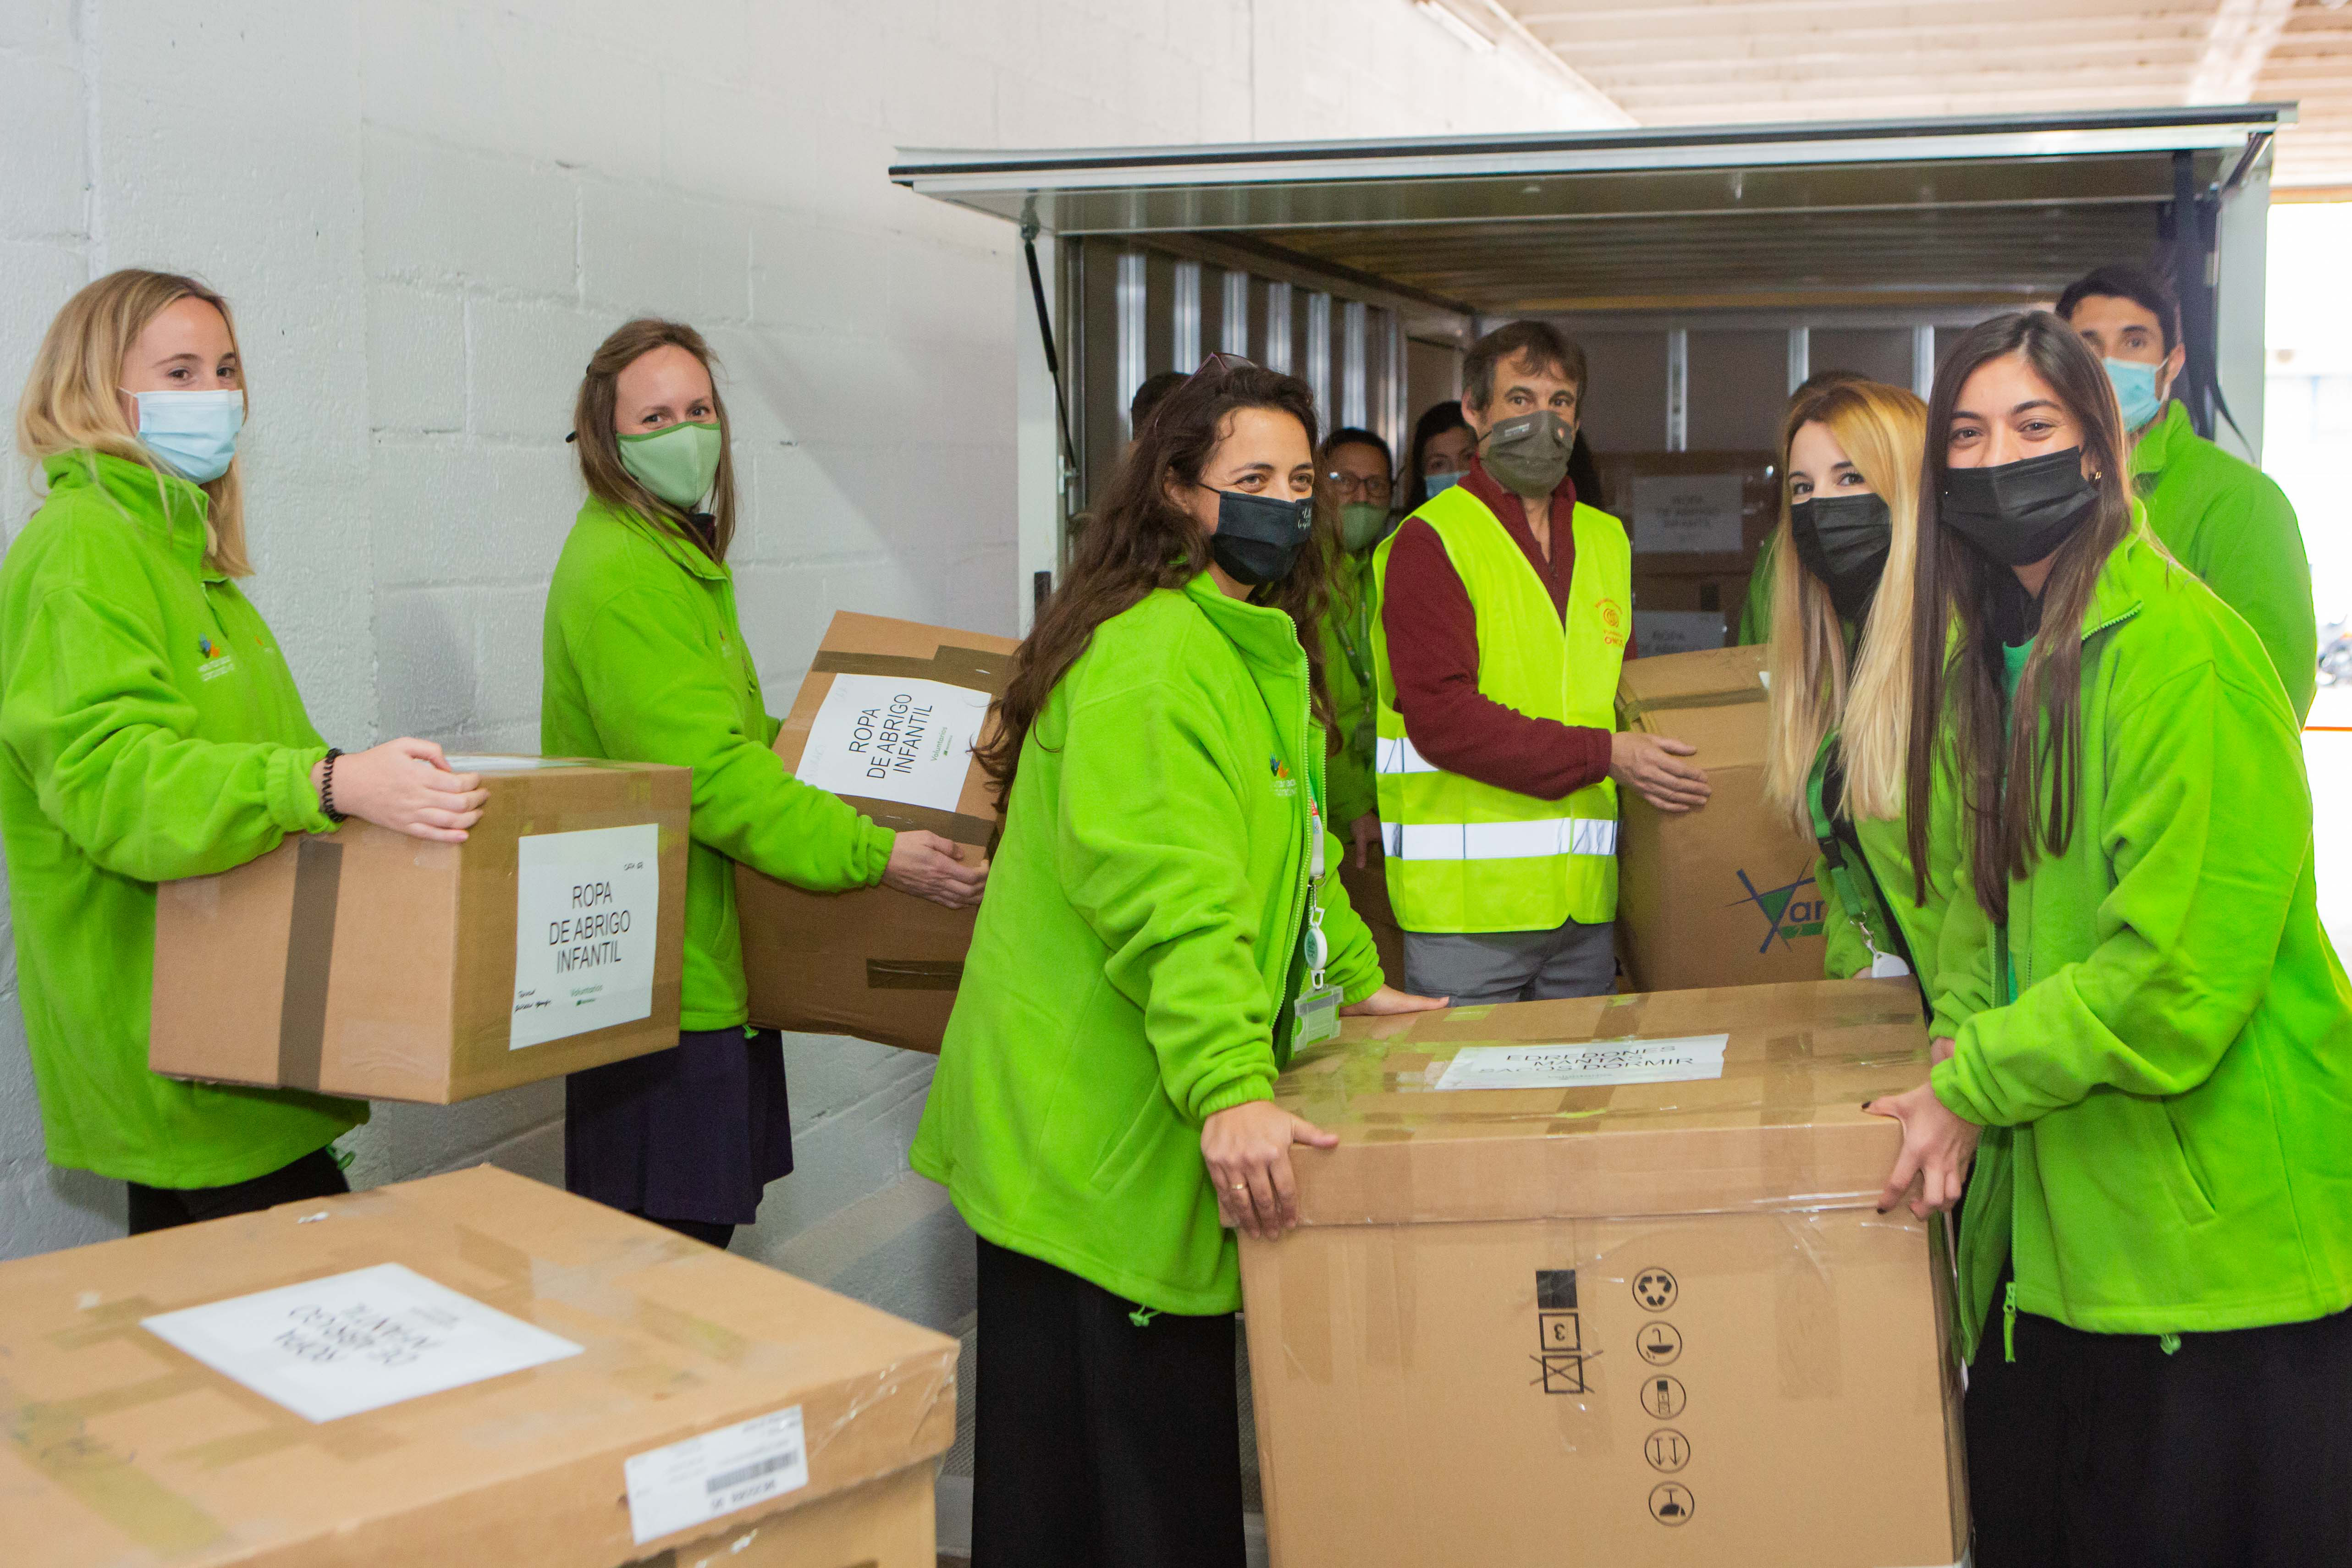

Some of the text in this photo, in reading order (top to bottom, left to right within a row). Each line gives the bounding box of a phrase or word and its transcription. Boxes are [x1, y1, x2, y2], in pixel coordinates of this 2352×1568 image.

[848, 708, 881, 753] ROPA
[866, 693, 913, 779] DE ABRIGO
[892, 705, 933, 774] INFANTIL
[572, 881, 613, 909] ROPA
[549, 910, 631, 946] DE ABRIGO
[556, 940, 622, 974] INFANTIL
[1506, 1045, 1675, 1061] EDREDONES
[1534, 1055, 1643, 1066] MANTAS
[1583, 1058, 1694, 1071] DORMIR
[1553, 1322, 1565, 1341] 3
